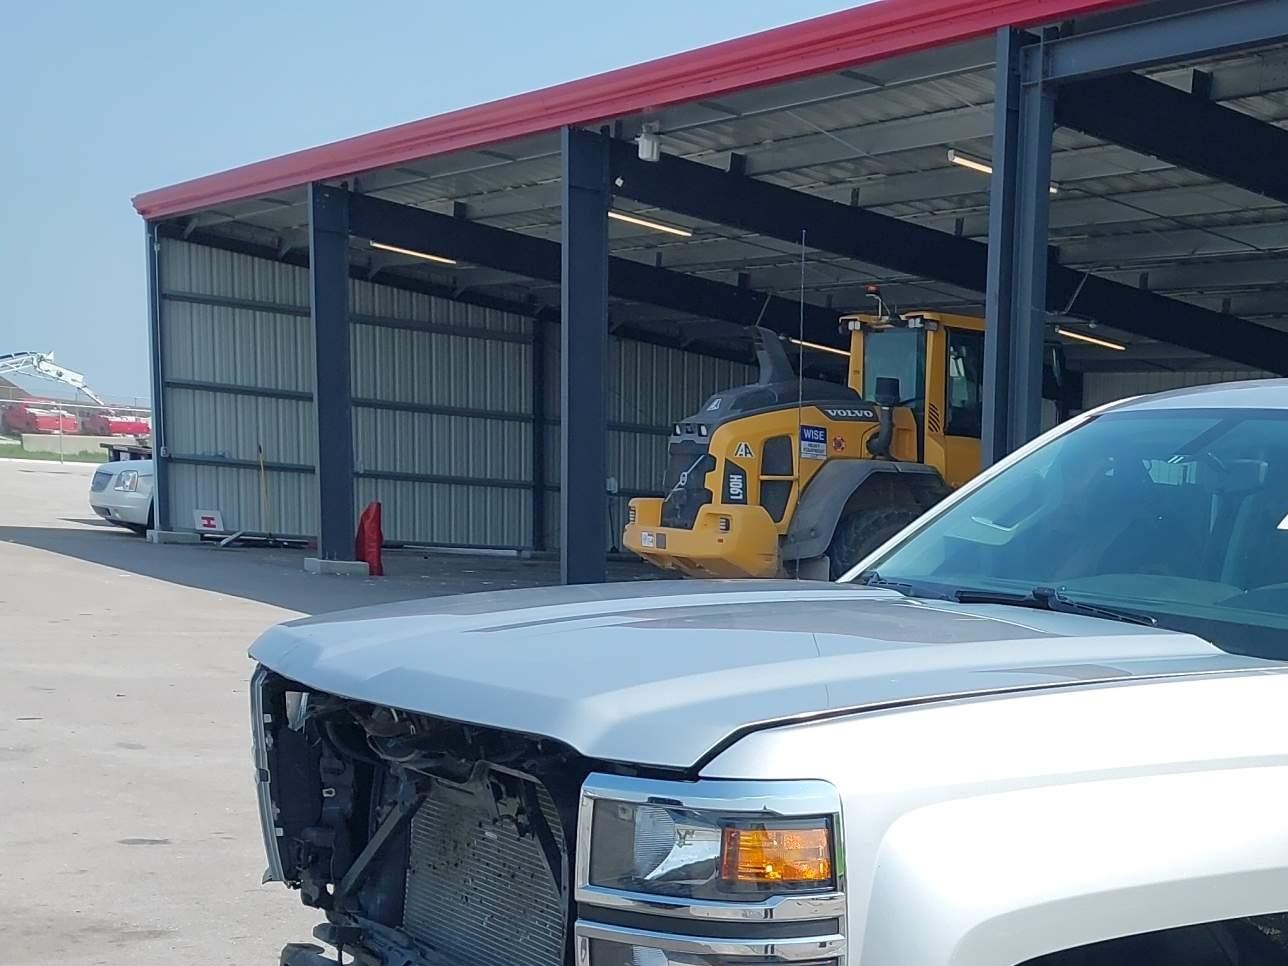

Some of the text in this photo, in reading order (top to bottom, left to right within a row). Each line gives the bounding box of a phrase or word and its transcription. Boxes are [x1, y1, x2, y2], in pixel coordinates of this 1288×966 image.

[825, 409, 874, 418] VOLVO
[803, 428, 825, 441] WISE
[729, 474, 743, 500] L90H
